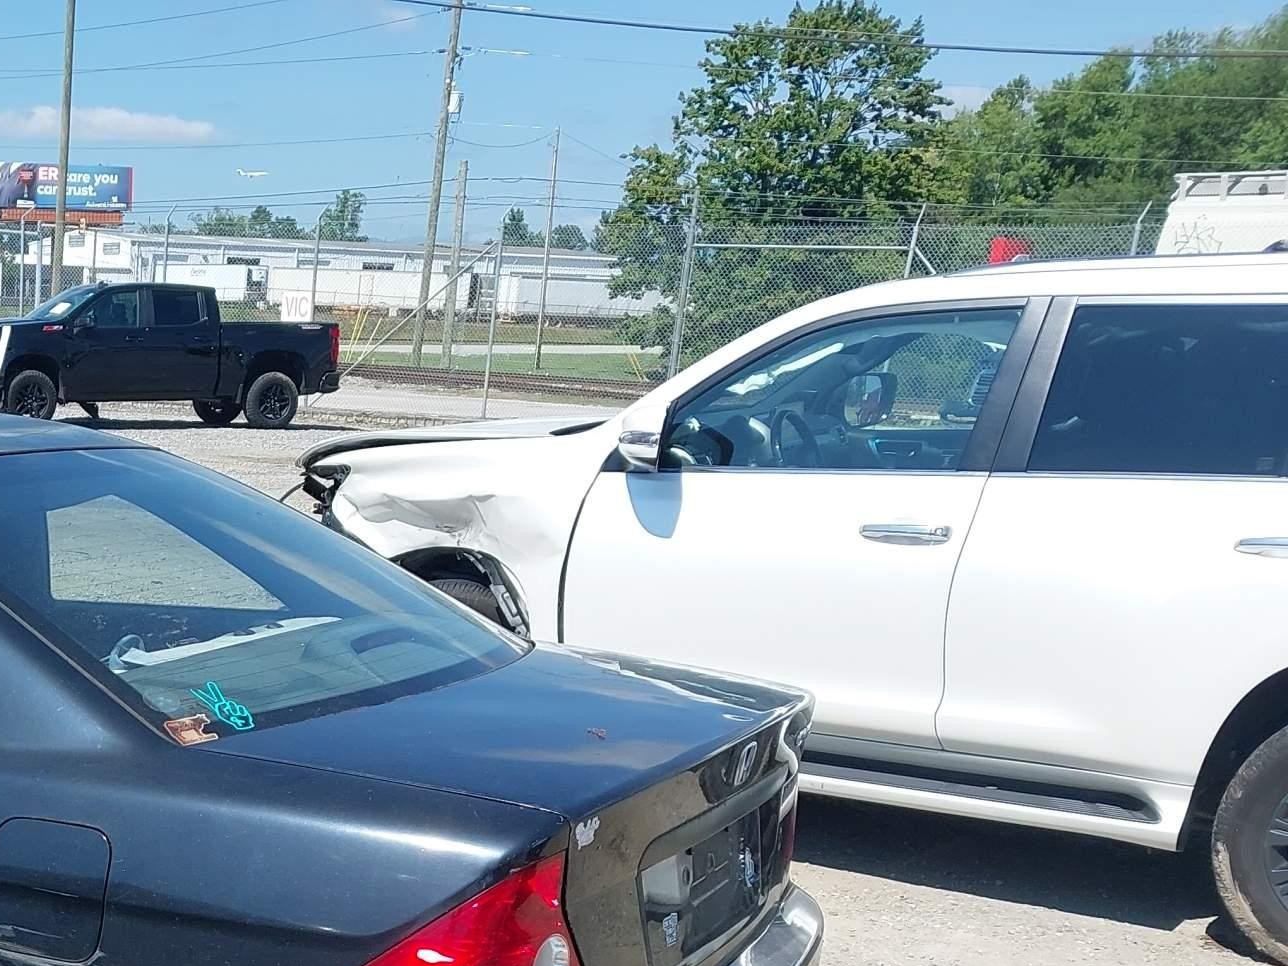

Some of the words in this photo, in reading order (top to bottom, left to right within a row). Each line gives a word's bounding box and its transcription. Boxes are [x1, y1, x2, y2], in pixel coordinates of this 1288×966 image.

[38, 166, 58, 181] ER
[94, 173, 118, 186] you
[285, 296, 309, 317] VIC
